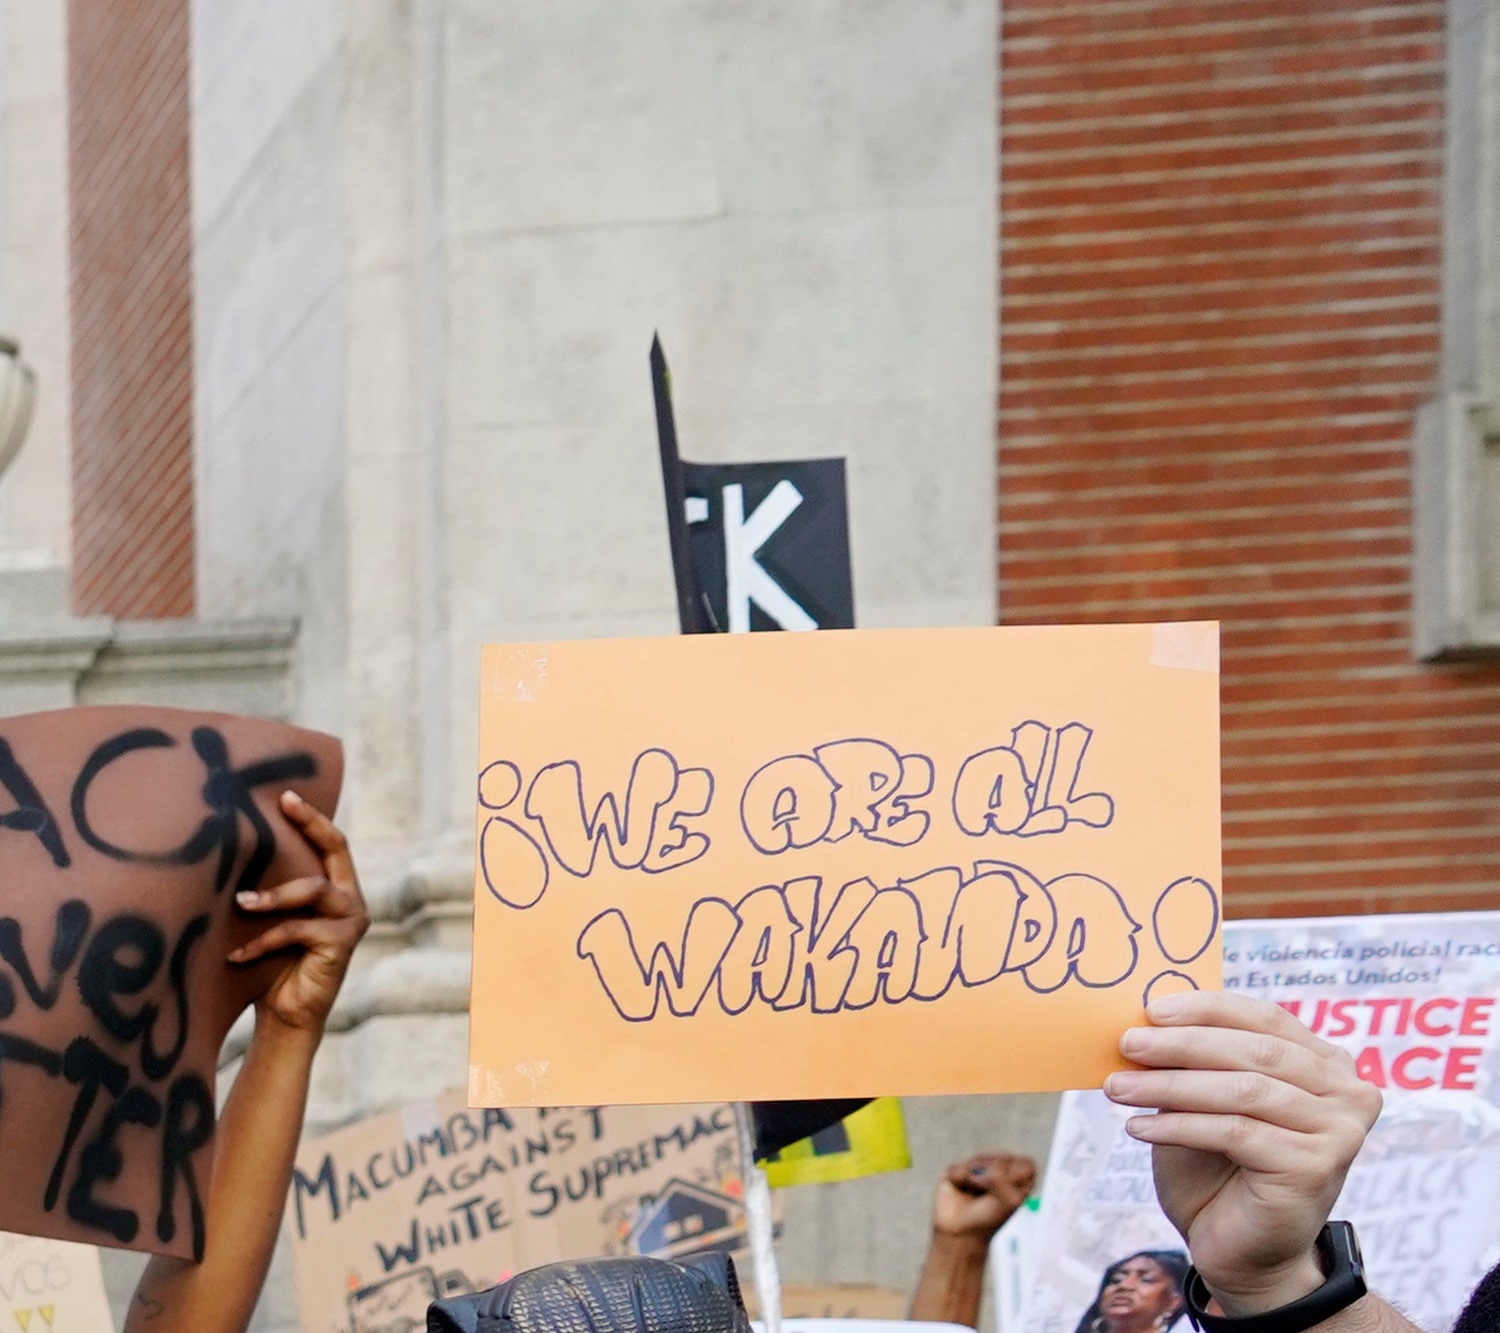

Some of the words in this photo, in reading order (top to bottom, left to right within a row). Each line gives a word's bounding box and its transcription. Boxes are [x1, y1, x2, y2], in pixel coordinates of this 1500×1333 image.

[740, 738, 936, 855] ARE
[952, 720, 1116, 838] ALL
[1246, 970, 1338, 989] Estados
[1345, 965, 1443, 986] Unidos!
[1247, 940, 1354, 963] violencia
[1358, 938, 1453, 963] policial
[1276, 997, 1497, 1038] USTICE
[1355, 1046, 1484, 1091] ACE
[290, 1107, 515, 1239] MACUMBA
[418, 1107, 606, 1207] AGAINST
[528, 1108, 736, 1219] SUPREMAC
